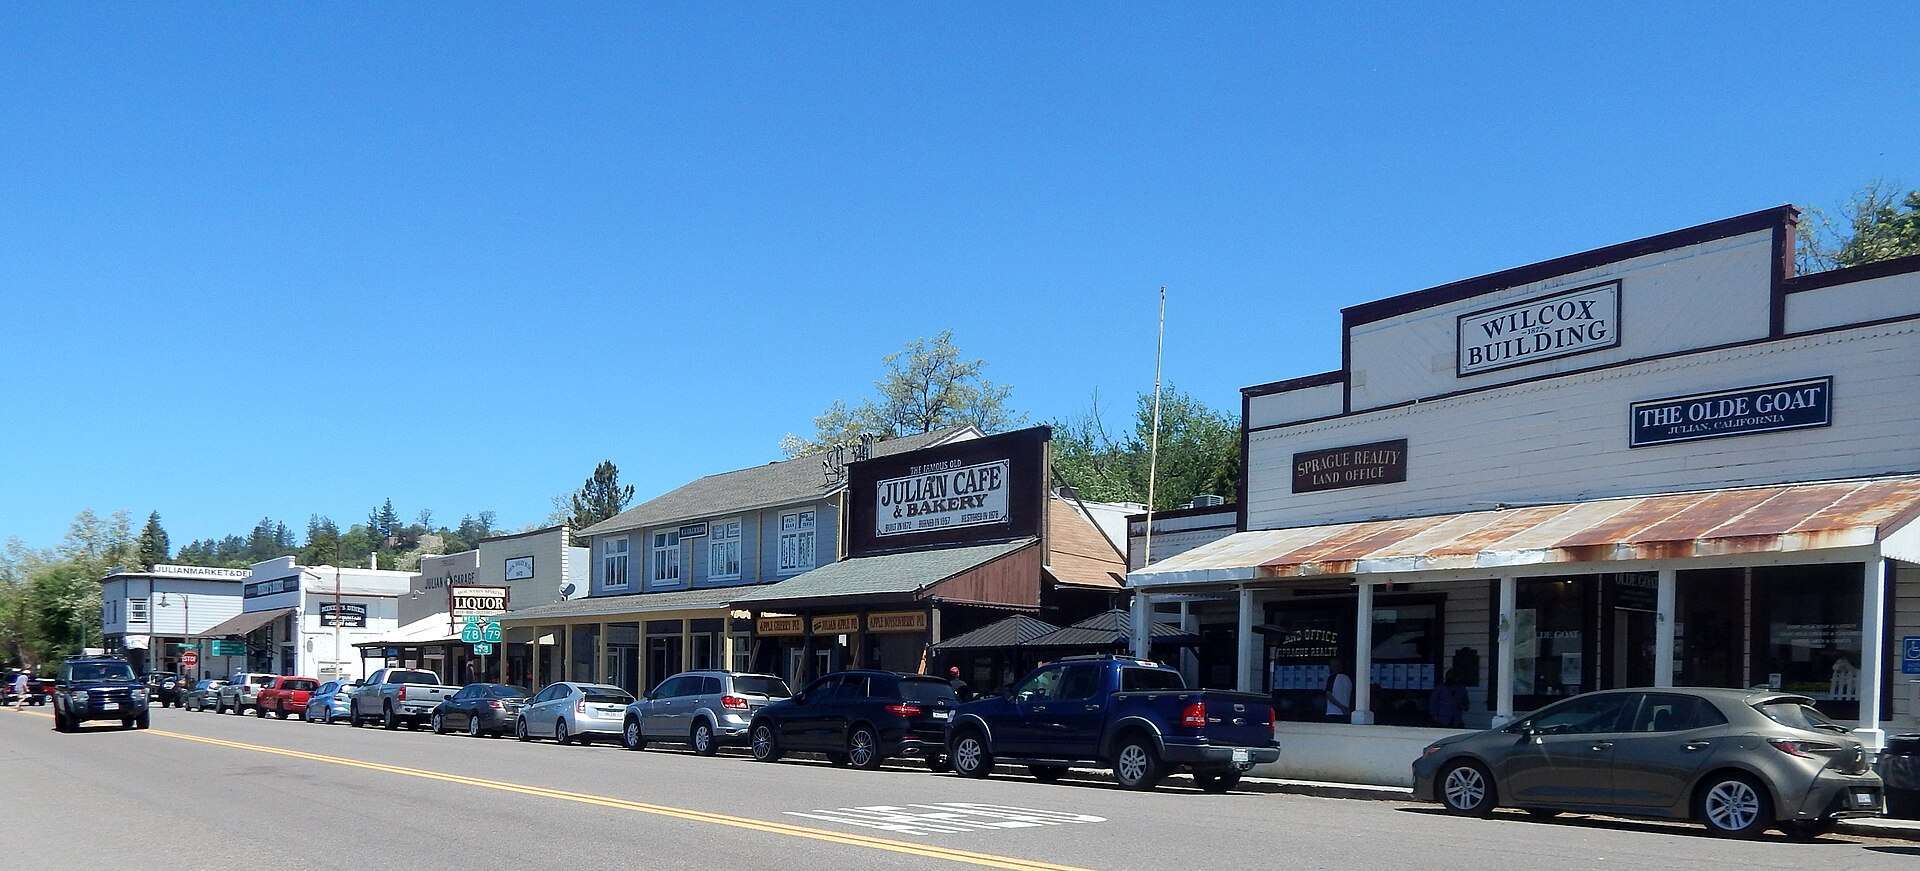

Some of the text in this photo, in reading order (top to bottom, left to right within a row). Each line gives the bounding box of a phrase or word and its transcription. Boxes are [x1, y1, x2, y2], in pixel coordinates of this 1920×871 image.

[1481, 299, 1596, 339] WILCOX
[1467, 319, 1607, 365] BUILDING
[1639, 387, 1821, 428] THE OLDE GOAT
[1714, 414, 1785, 430] CALIFORNIA
[910, 459, 962, 475] THE FAMOUS OLD
[1298, 450, 1400, 477] SPRAGUE REALTY
[1313, 466, 1384, 485] LAND OFFICE
[881, 466, 1001, 507] JULIAN CAFE
[893, 494, 988, 519] & BAKERY
[885, 523, 896, 532] BUILT
[918, 518, 934, 528] BURNED
[961, 512, 982, 523] RESTORED
[453, 572, 475, 584] GARAGE
[455, 597, 504, 610] LIQUOR
[464, 630, 479, 640] 78
[488, 630, 501, 640] 79
[1304, 629, 1338, 644] OFFICE
[1310, 647, 1338, 657] REALTY
